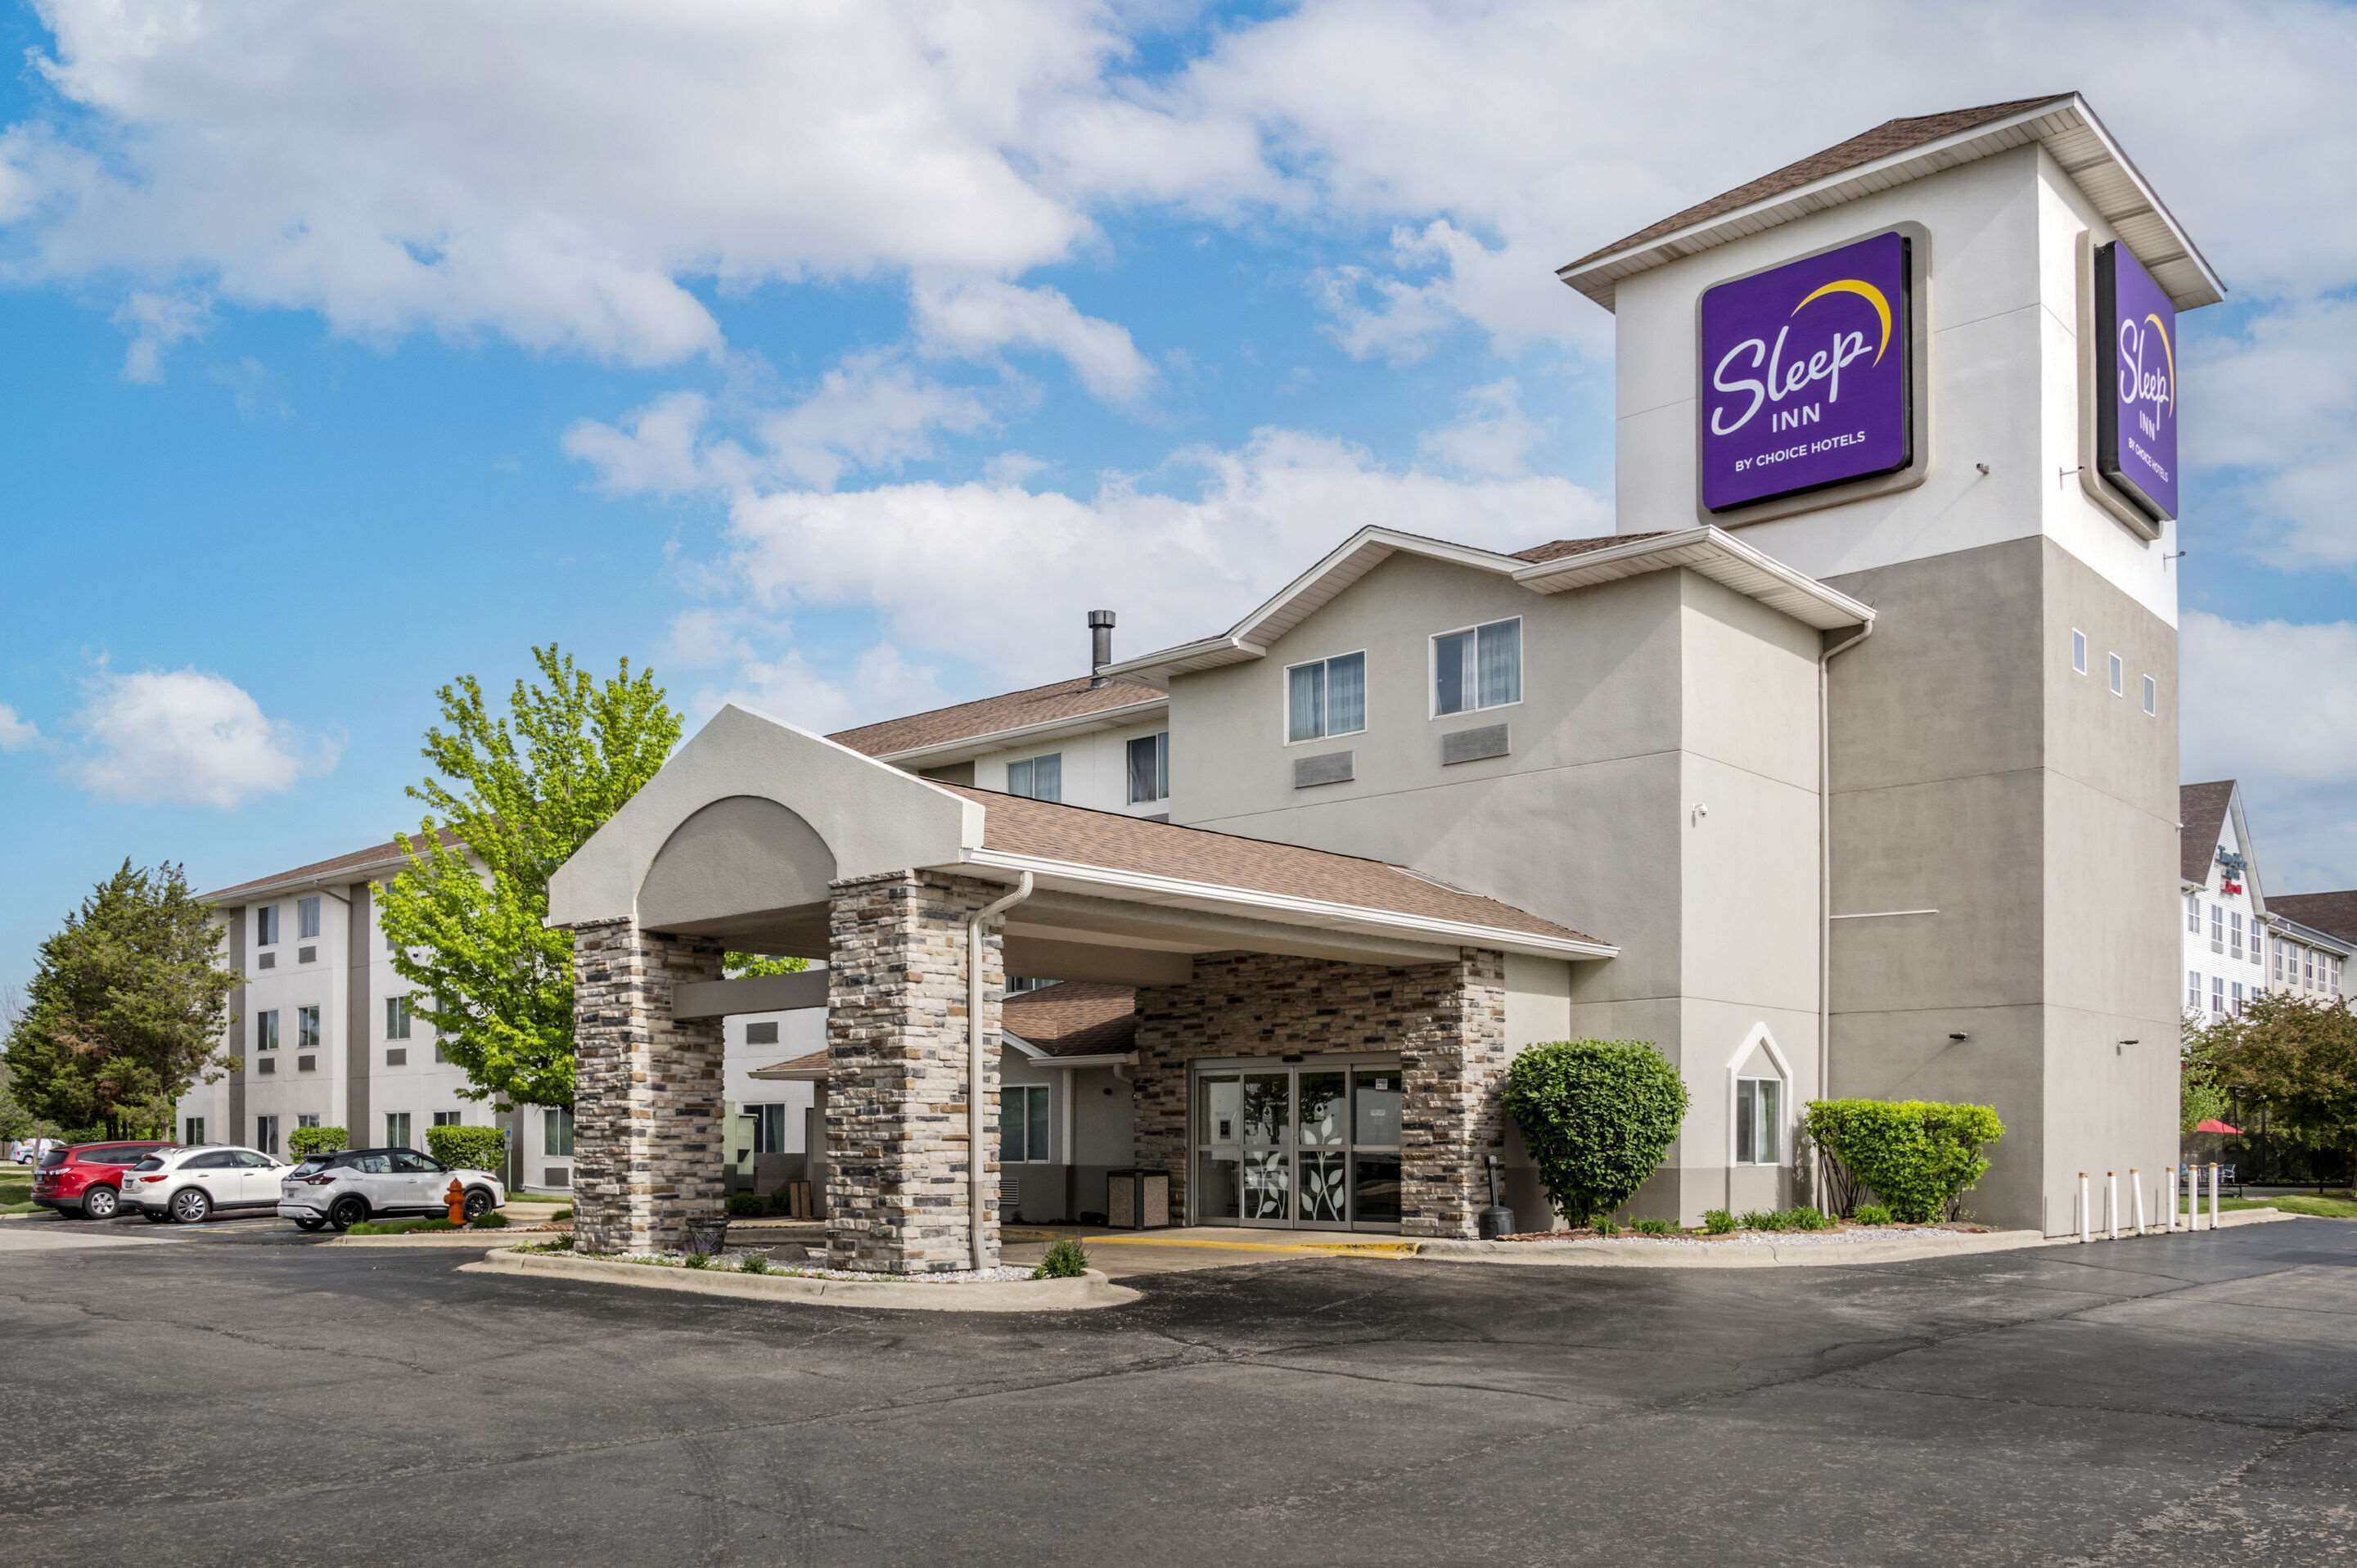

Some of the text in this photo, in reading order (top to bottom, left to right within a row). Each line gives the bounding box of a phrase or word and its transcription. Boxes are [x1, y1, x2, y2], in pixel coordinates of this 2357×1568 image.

[1711, 326, 1873, 435] Sleep
[2120, 318, 2169, 431] Sleep
[1773, 403, 1820, 432] INN
[2139, 410, 2156, 441] INN
[1735, 431, 1865, 471] BY CHOICE HOTELS
[2128, 437, 2169, 483] BY CHOICE HOTELS
